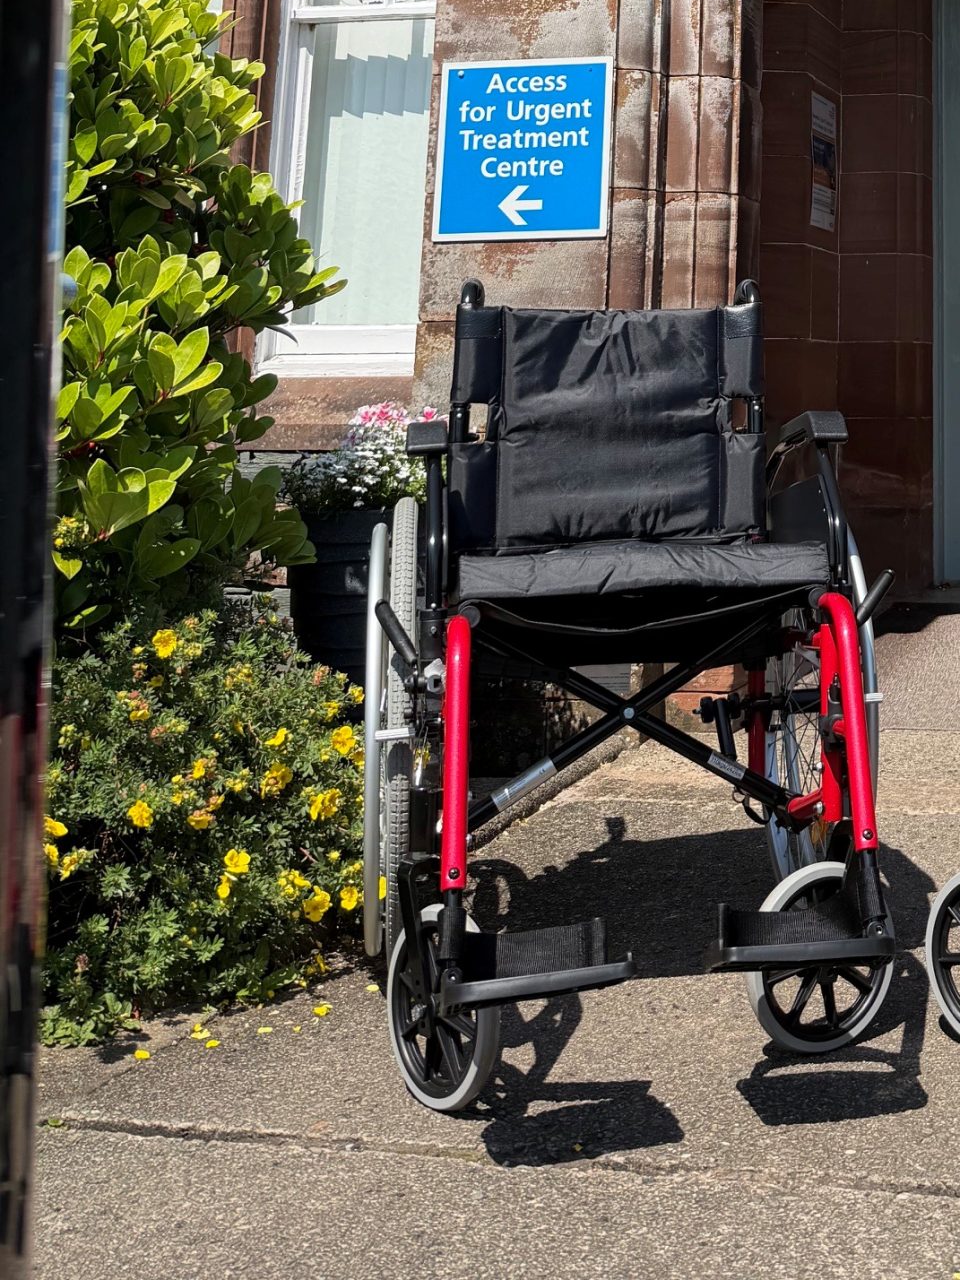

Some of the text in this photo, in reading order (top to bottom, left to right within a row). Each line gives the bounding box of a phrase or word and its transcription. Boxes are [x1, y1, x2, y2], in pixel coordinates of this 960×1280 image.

[486, 73, 567, 94] Access
[458, 98, 592, 126] for Urgent
[458, 126, 590, 151] Treatment
[480, 156, 564, 178] Centre
